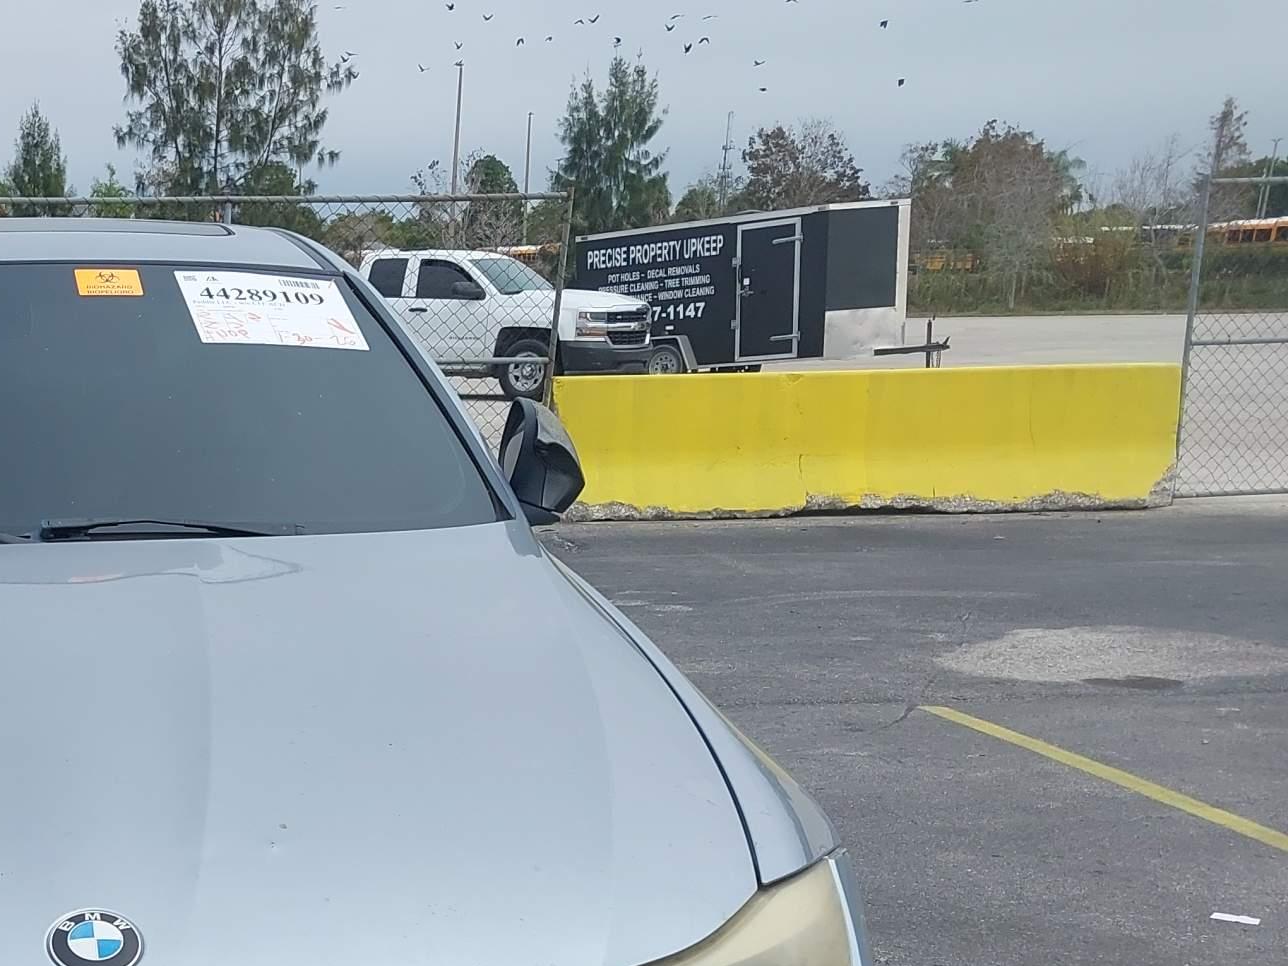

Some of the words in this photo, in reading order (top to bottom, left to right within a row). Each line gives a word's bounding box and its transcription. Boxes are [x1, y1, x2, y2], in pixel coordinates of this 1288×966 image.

[587, 247, 628, 270] PRECISE
[629, 240, 682, 266] PROPERTY
[683, 235, 724, 259] UPKEEP
[608, 273, 620, 284] POT
[620, 271, 641, 282] HOLES
[647, 268, 667, 279] DECAL
[667, 263, 700, 277] REMOVALS
[630, 280, 659, 292] CLEANING
[664, 278, 680, 290] TREE
[681, 274, 711, 287] TRIMMING
[200, 286, 325, 305] 44289109
[657, 289, 683, 301] WINDOW
[684, 285, 715, 298] CLEANING
[652, 302, 705, 321] 7-1147
[58, 912, 131, 932] BMW
